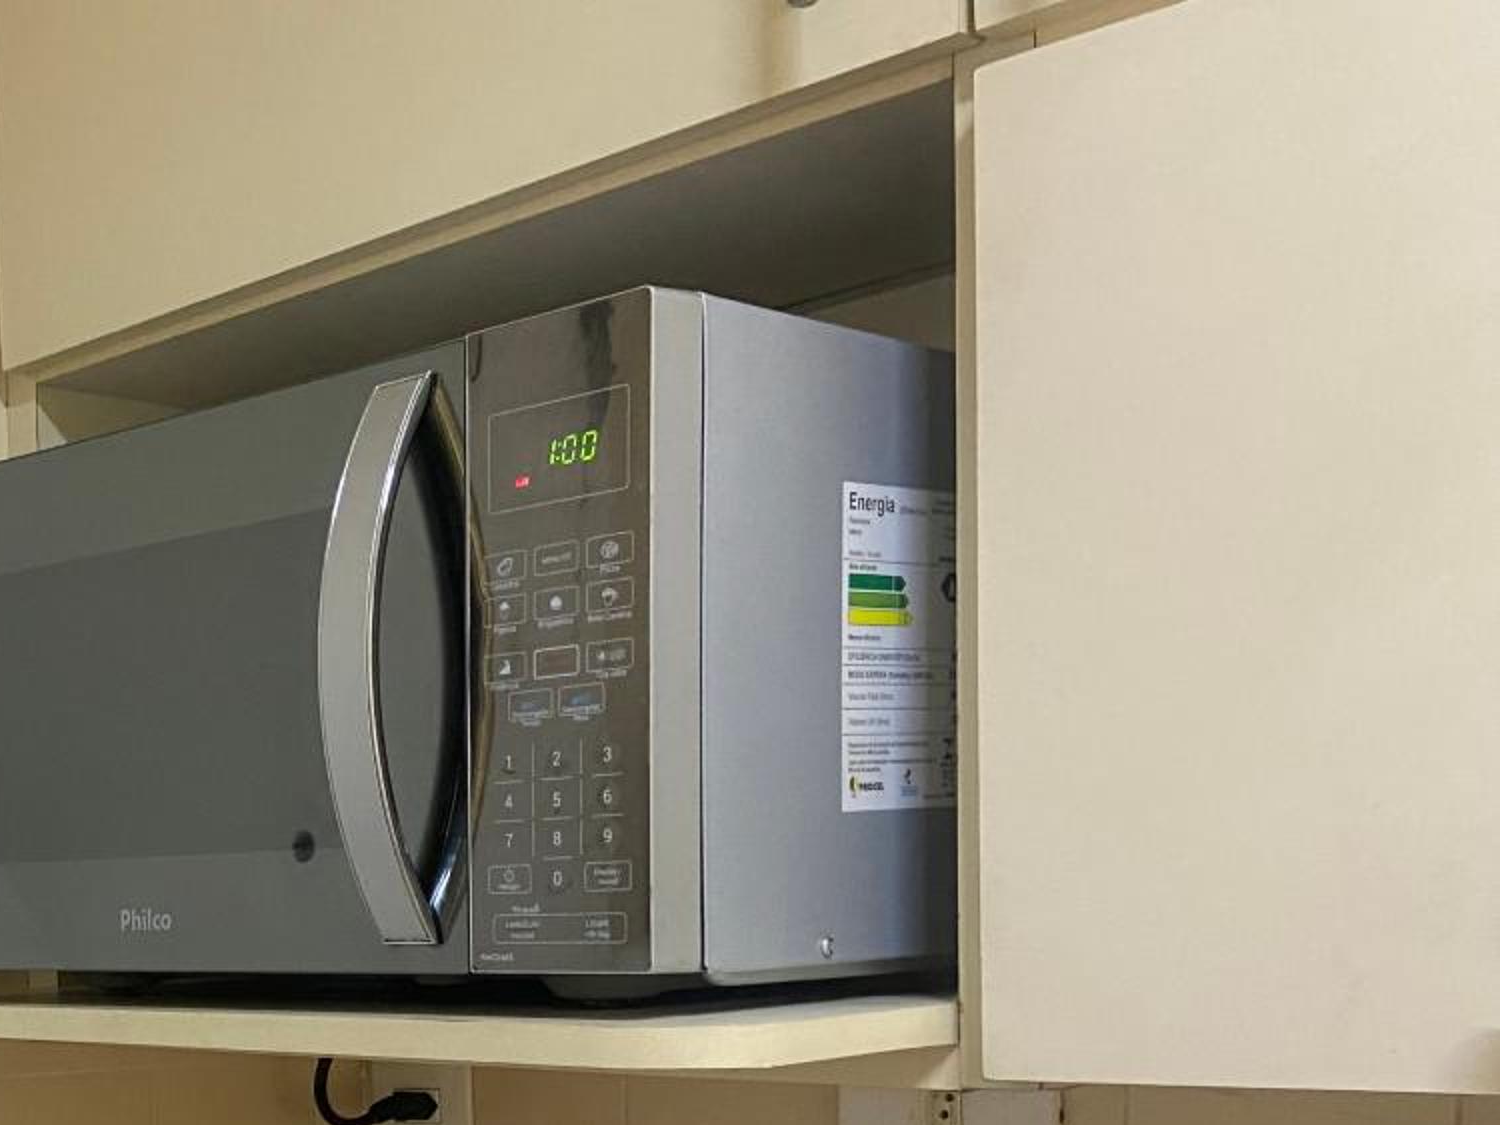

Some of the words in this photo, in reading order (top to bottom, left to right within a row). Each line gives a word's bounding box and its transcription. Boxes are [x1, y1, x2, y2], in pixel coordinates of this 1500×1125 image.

[549, 429, 598, 465] 1:00
[849, 491, 895, 517] Energia
[505, 754, 513, 770] 1
[552, 751, 561, 767] 2
[603, 747, 612, 762] 3
[504, 794, 513, 808] 4
[552, 791, 561, 808] 5
[603, 788, 612, 804] 6
[505, 833, 513, 849] 7
[553, 831, 561, 846] 8
[603, 828, 612, 843] 9
[553, 871, 562, 887] 0
[120, 907, 172, 931] Philco
